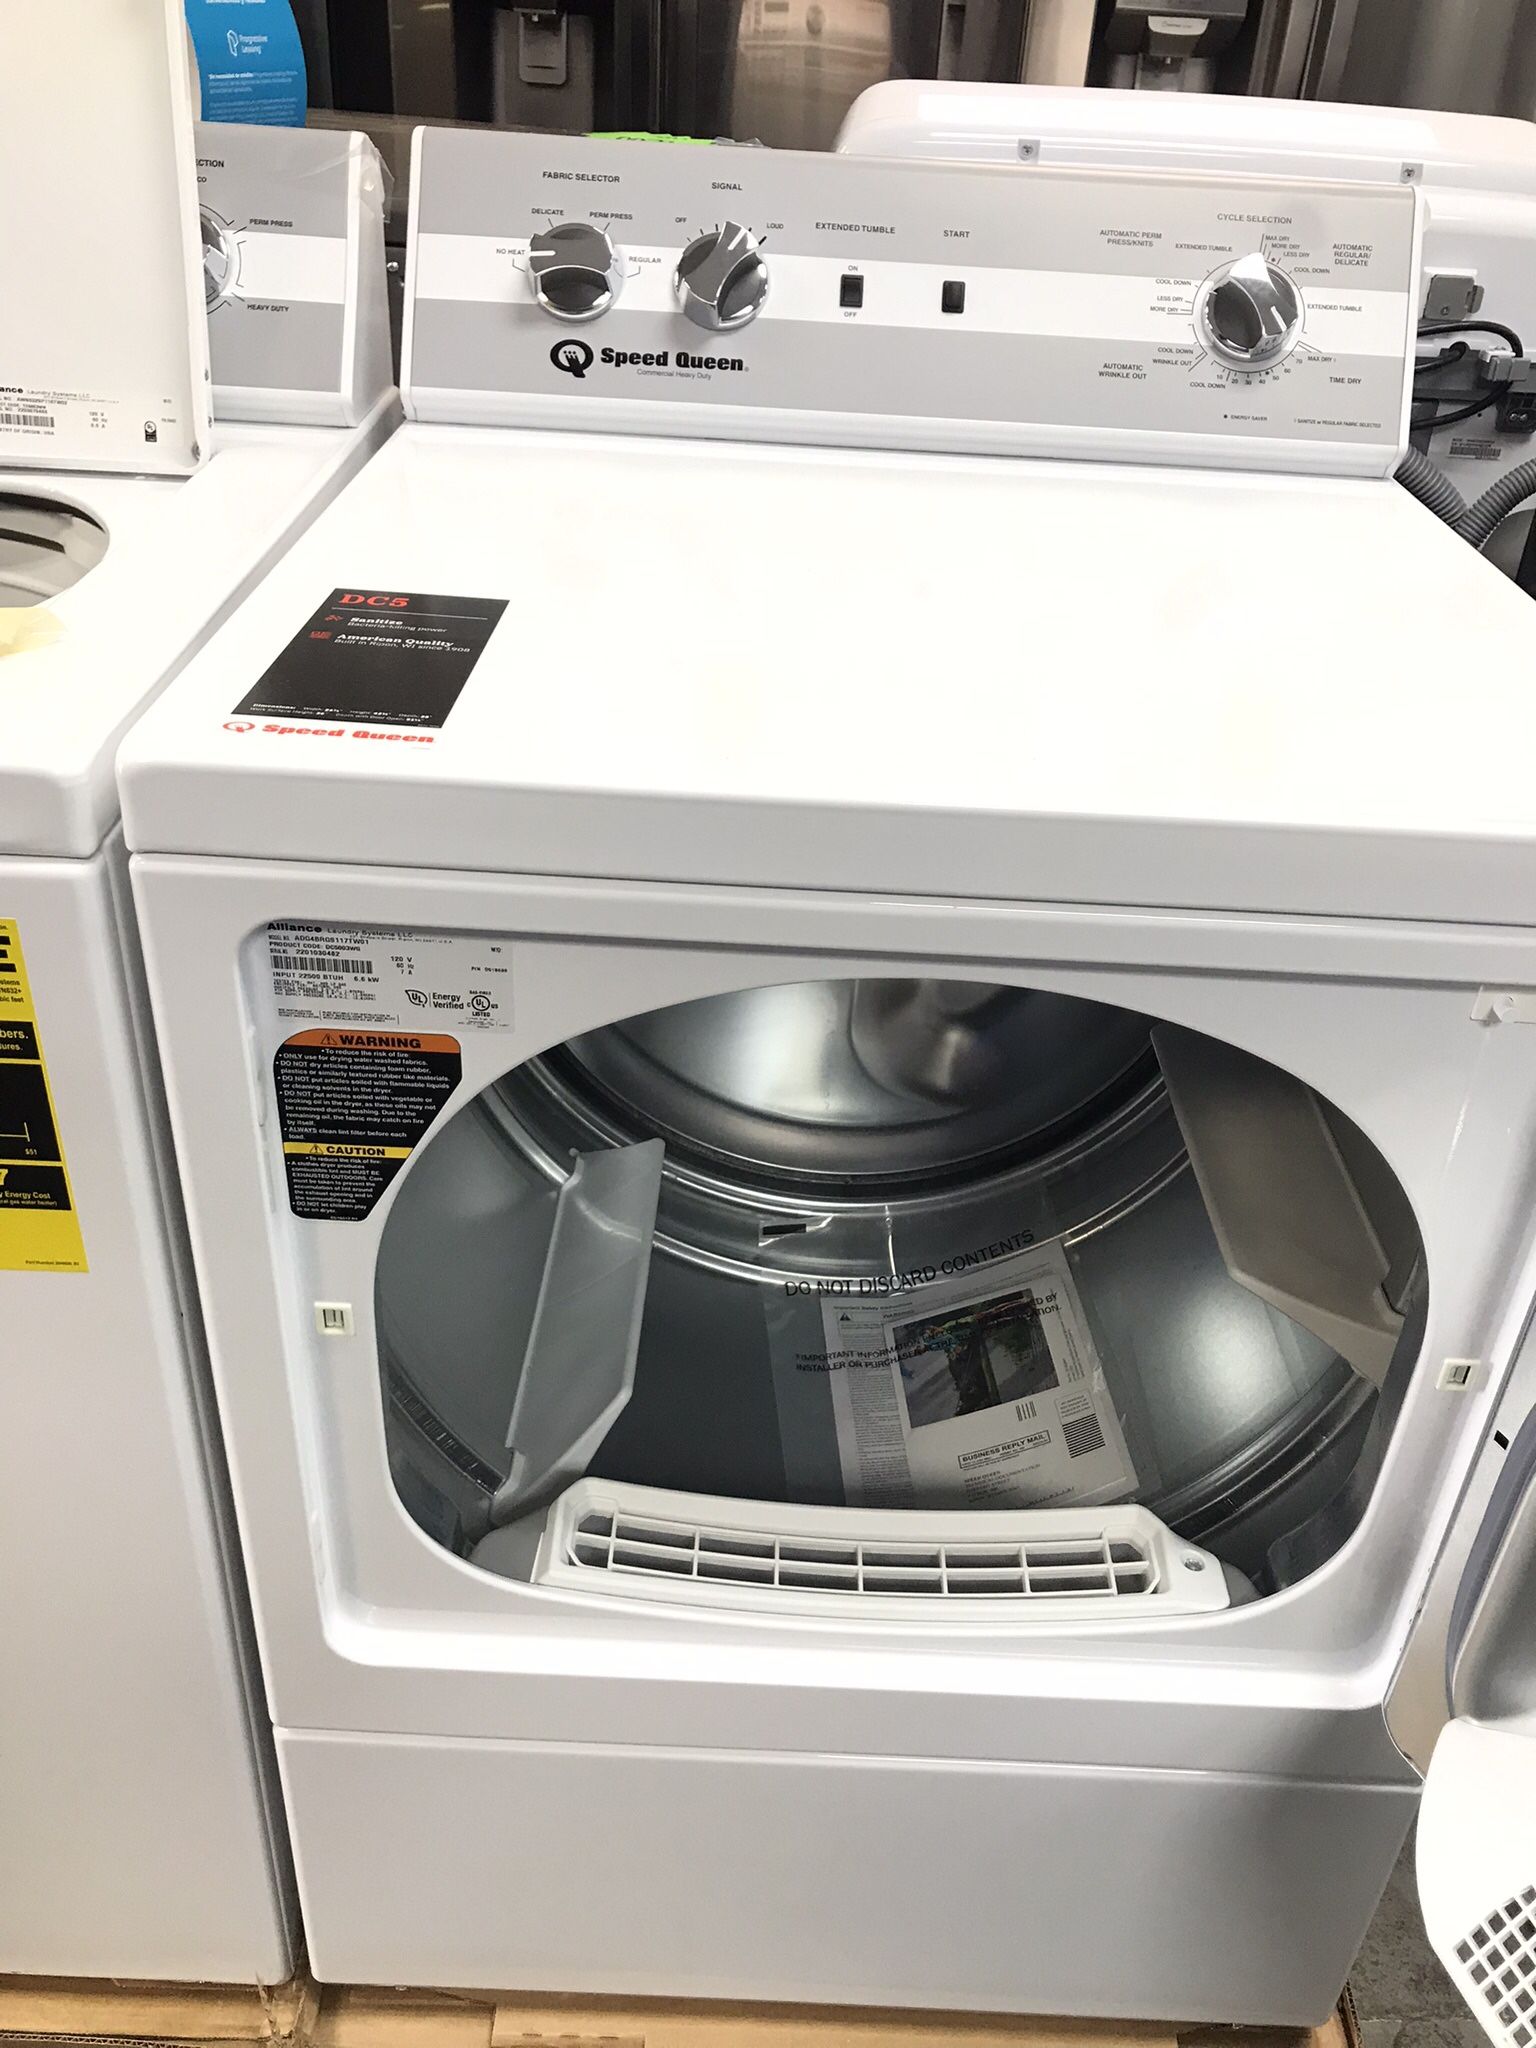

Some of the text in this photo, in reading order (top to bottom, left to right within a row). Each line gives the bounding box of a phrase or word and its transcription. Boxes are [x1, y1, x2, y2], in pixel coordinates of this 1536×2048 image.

[542, 171, 620, 183] FABRIC SELECTOR
[711, 182, 743, 191] SIGNAL
[531, 208, 564, 216] DELICATE
[1217, 213, 1292, 224] CYCLE SELECTION
[815, 222, 896, 234] EXTENDED TUMBLE
[943, 230, 970, 238] START
[1100, 229, 1140, 238] AUTOMATIC
[1107, 238, 1154, 247] PRESS/KNITS
[1332, 243, 1373, 251] AUTOMATIC
[629, 256, 662, 264] REGULAR
[1334, 251, 1371, 259] REGULAR/
[1335, 259, 1369, 267] DELICATE
[601, 348, 744, 371] Speed Queen
[1103, 363, 1143, 371] AUTOMATIC
[637, 369, 712, 380] Commercial Heavy Duty
[339, 594, 410, 607] DC5
[350, 617, 403, 625] Sanitize
[348, 622, 416, 631] Bacteria-killing
[336, 634, 454, 647] American Quality
[262, 724, 434, 743] Speed Queen
[267, 922, 322, 933] Alliance
[327, 928, 360, 936] Laundry
[361, 930, 395, 938] Systems
[411, 993, 423, 1003] UL
[433, 992, 461, 1002] Energy
[433, 1001, 464, 1009] Verified
[475, 999, 486, 1008] UL
[339, 1035, 421, 1049] WARNING
[326, 1146, 385, 1156] CAUTION
[5, 1191, 31, 1199] Energy
[785, 1228, 1035, 1297] DO NOT DISCARD CONTENTS
[848, 1359, 863, 1369] OR
[962, 1448, 1000, 1462] BUSINESS
[1001, 1440, 1026, 1451] REPLY
[1026, 1434, 1045, 1443] MAIL
